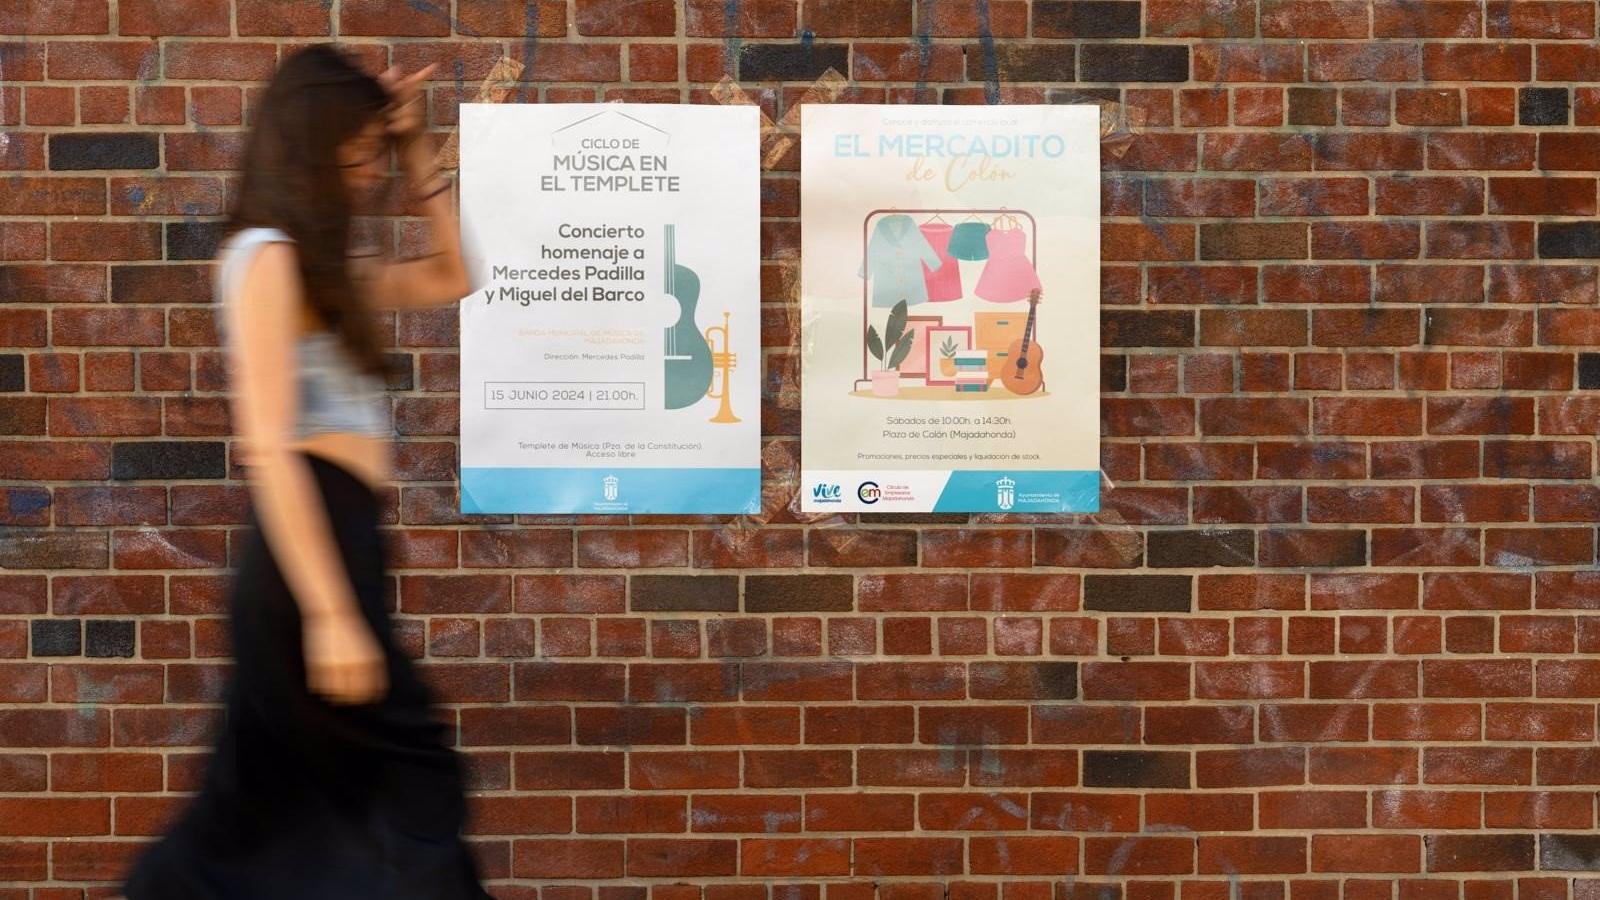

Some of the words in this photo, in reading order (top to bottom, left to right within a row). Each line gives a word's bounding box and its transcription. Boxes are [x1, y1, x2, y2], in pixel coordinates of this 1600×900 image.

[581, 138, 620, 149] CICLO
[622, 139, 640, 149] DE
[833, 133, 870, 157] EL
[878, 133, 1066, 158] MERCADITO
[553, 150, 635, 171] MÚSICA
[640, 155, 668, 171] EN
[905, 155, 937, 182] de
[944, 153, 1015, 192] Colón
[541, 175, 566, 192] EL
[570, 176, 680, 192] TEMPLETE
[558, 223, 645, 239] Concierto
[541, 244, 630, 265] homenaje
[633, 248, 645, 260] a
[492, 265, 581, 281] Mercedes
[585, 265, 645, 281] Padilla
[484, 290, 495, 304] y
[500, 287, 557, 307] Miguel
[561, 287, 588, 302] del
[592, 288, 645, 302] Barco
[581, 352, 618, 361] Mercedes
[620, 352, 645, 361] Padilla
[491, 390, 504, 401] 15
[508, 390, 549, 401] JUNIO
[552, 390, 585, 401] 2024
[886, 416, 926, 425] Sábados
[928, 416, 940, 425] de
[882, 430, 907, 439] Plaza
[908, 430, 920, 439] de
[922, 429, 948, 439] Colón
[949, 430, 1016, 440] (Majadahonda)
[518, 441, 556, 451] Templete
[558, 441, 569, 450] de
[571, 441, 599, 450] Música
[624, 441, 635, 450] de
[637, 441, 645, 450] la
[585, 450, 616, 458] Acceso
[617, 450, 636, 458] libre
[813, 483, 841, 498] vive
